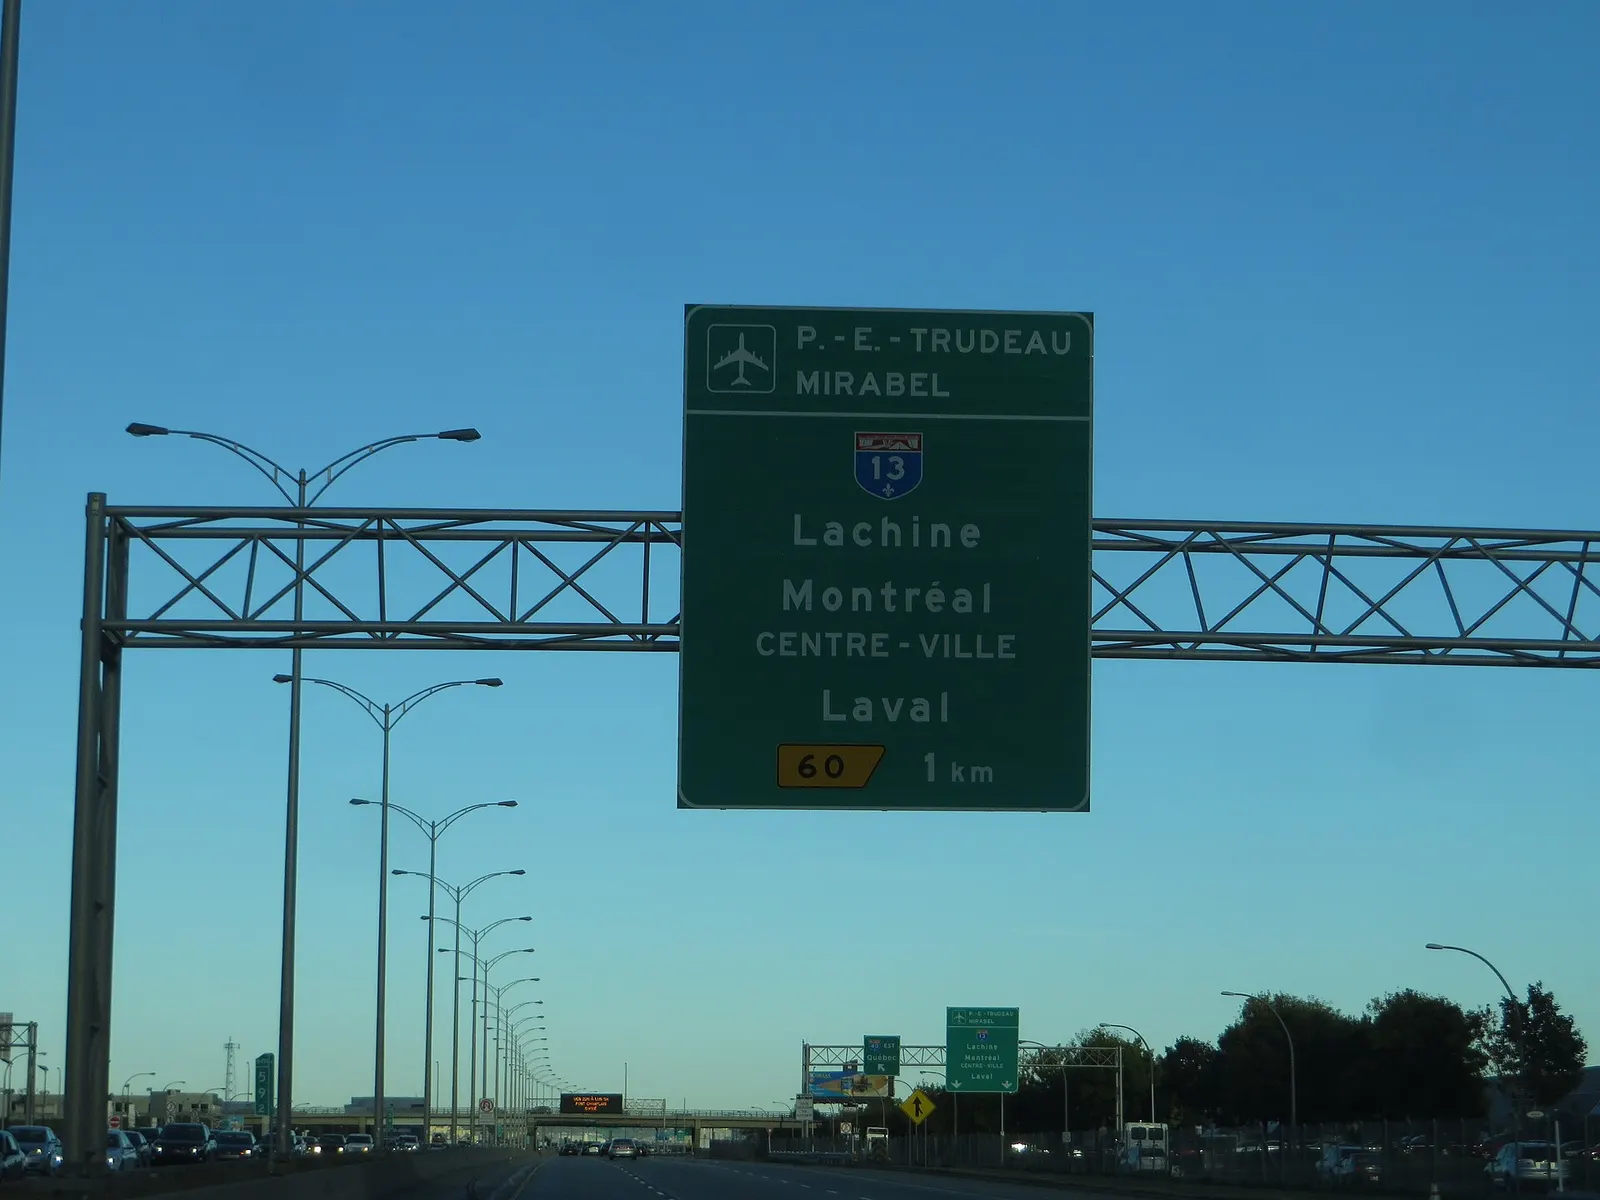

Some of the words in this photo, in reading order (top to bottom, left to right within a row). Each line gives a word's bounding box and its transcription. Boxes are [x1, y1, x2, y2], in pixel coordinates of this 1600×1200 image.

[796, 370, 951, 398] MIRABEL
[871, 455, 906, 481] 13
[793, 513, 982, 548] Lachine
[782, 578, 992, 614] Montréal
[822, 688, 949, 723] Laval
[797, 754, 845, 779] 60
[924, 752, 936, 783] 1
[951, 761, 994, 784] km
[866, 1053, 897, 1061] Québec
